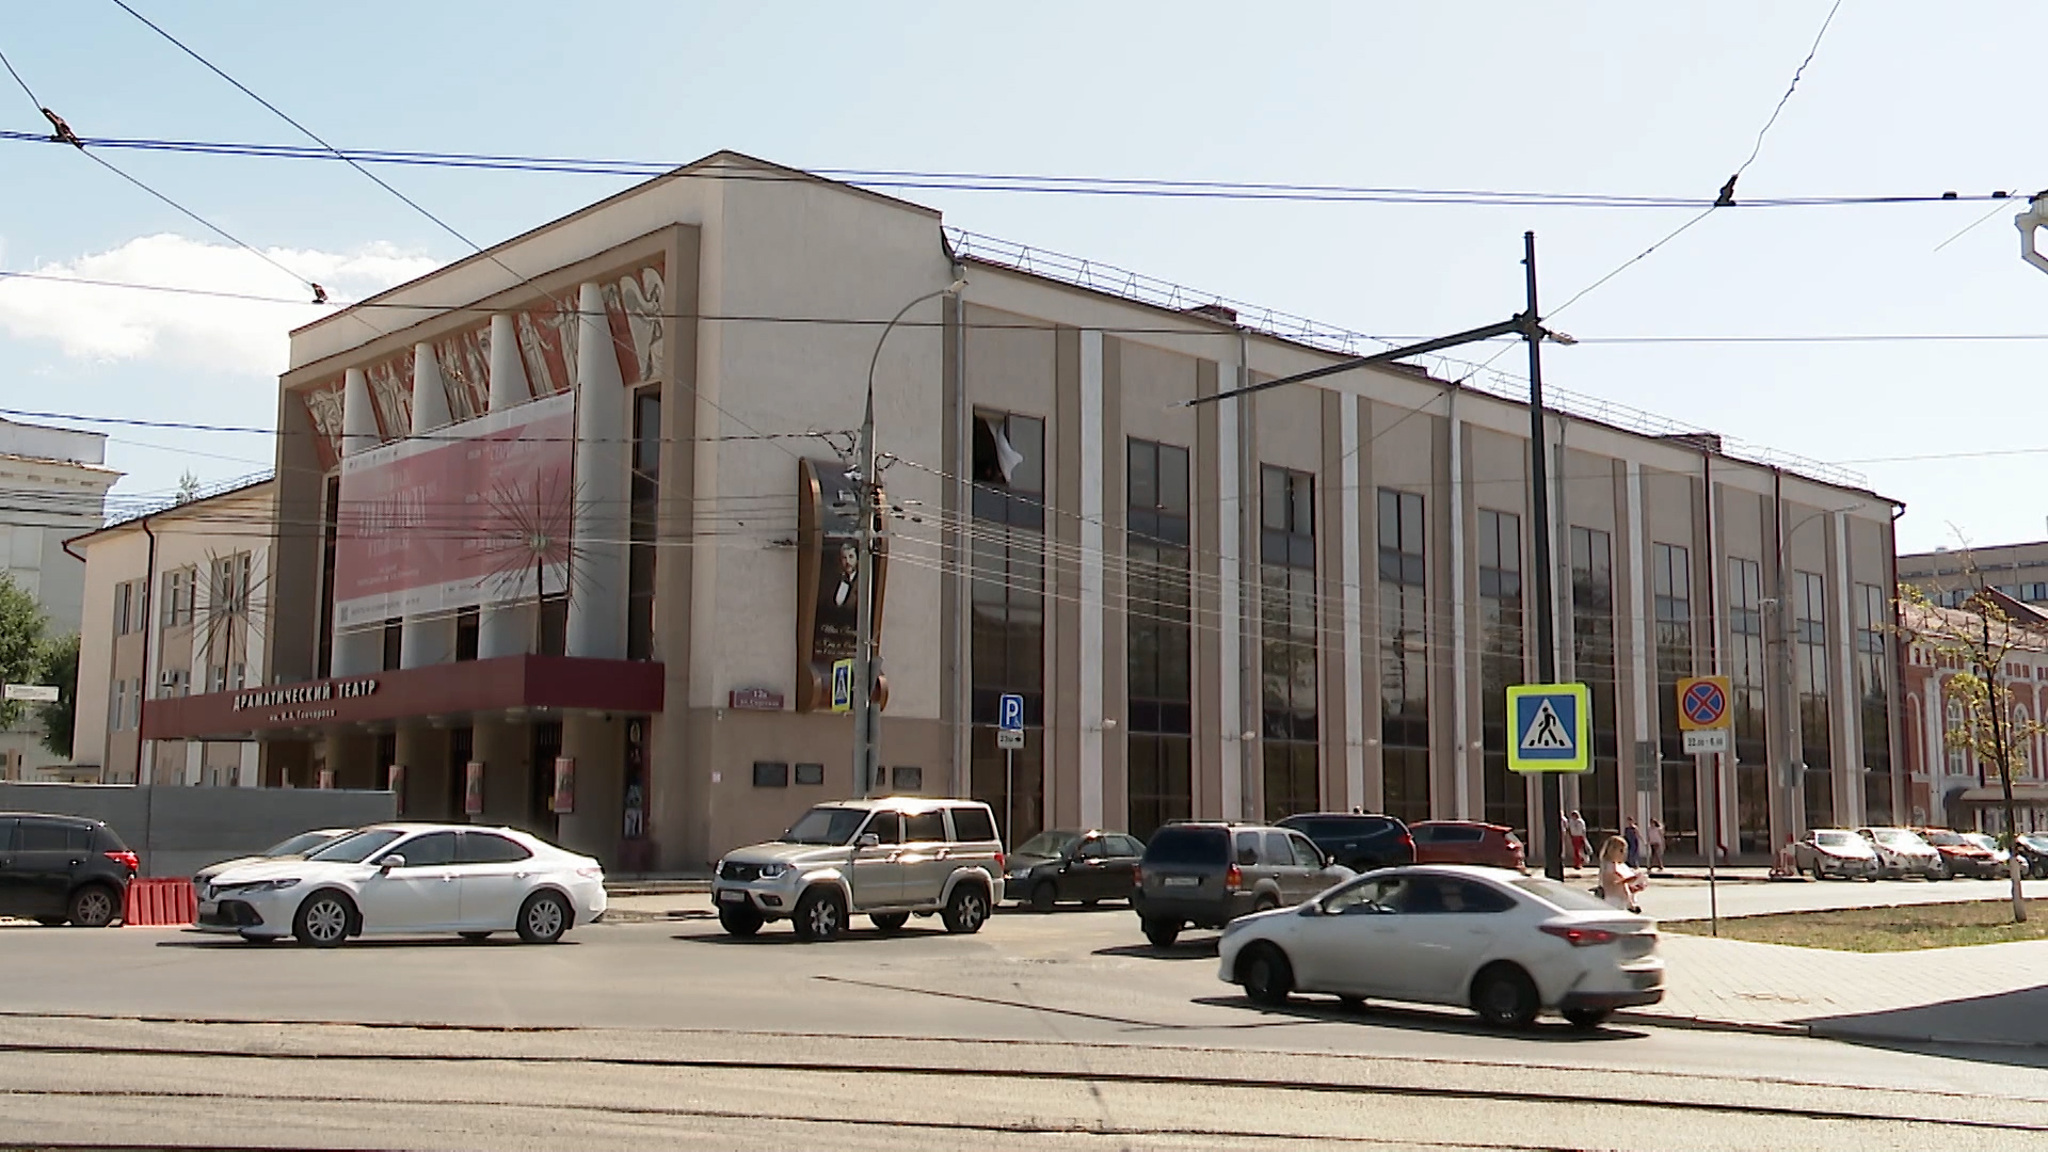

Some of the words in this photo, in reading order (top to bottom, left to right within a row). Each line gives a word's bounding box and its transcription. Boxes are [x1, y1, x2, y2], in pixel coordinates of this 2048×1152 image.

[232, 682, 331, 712] ДРАМАТИЧЕСКИЙ
[338, 679, 376, 699] ТЕАТР
[1006, 699, 1019, 725] P
